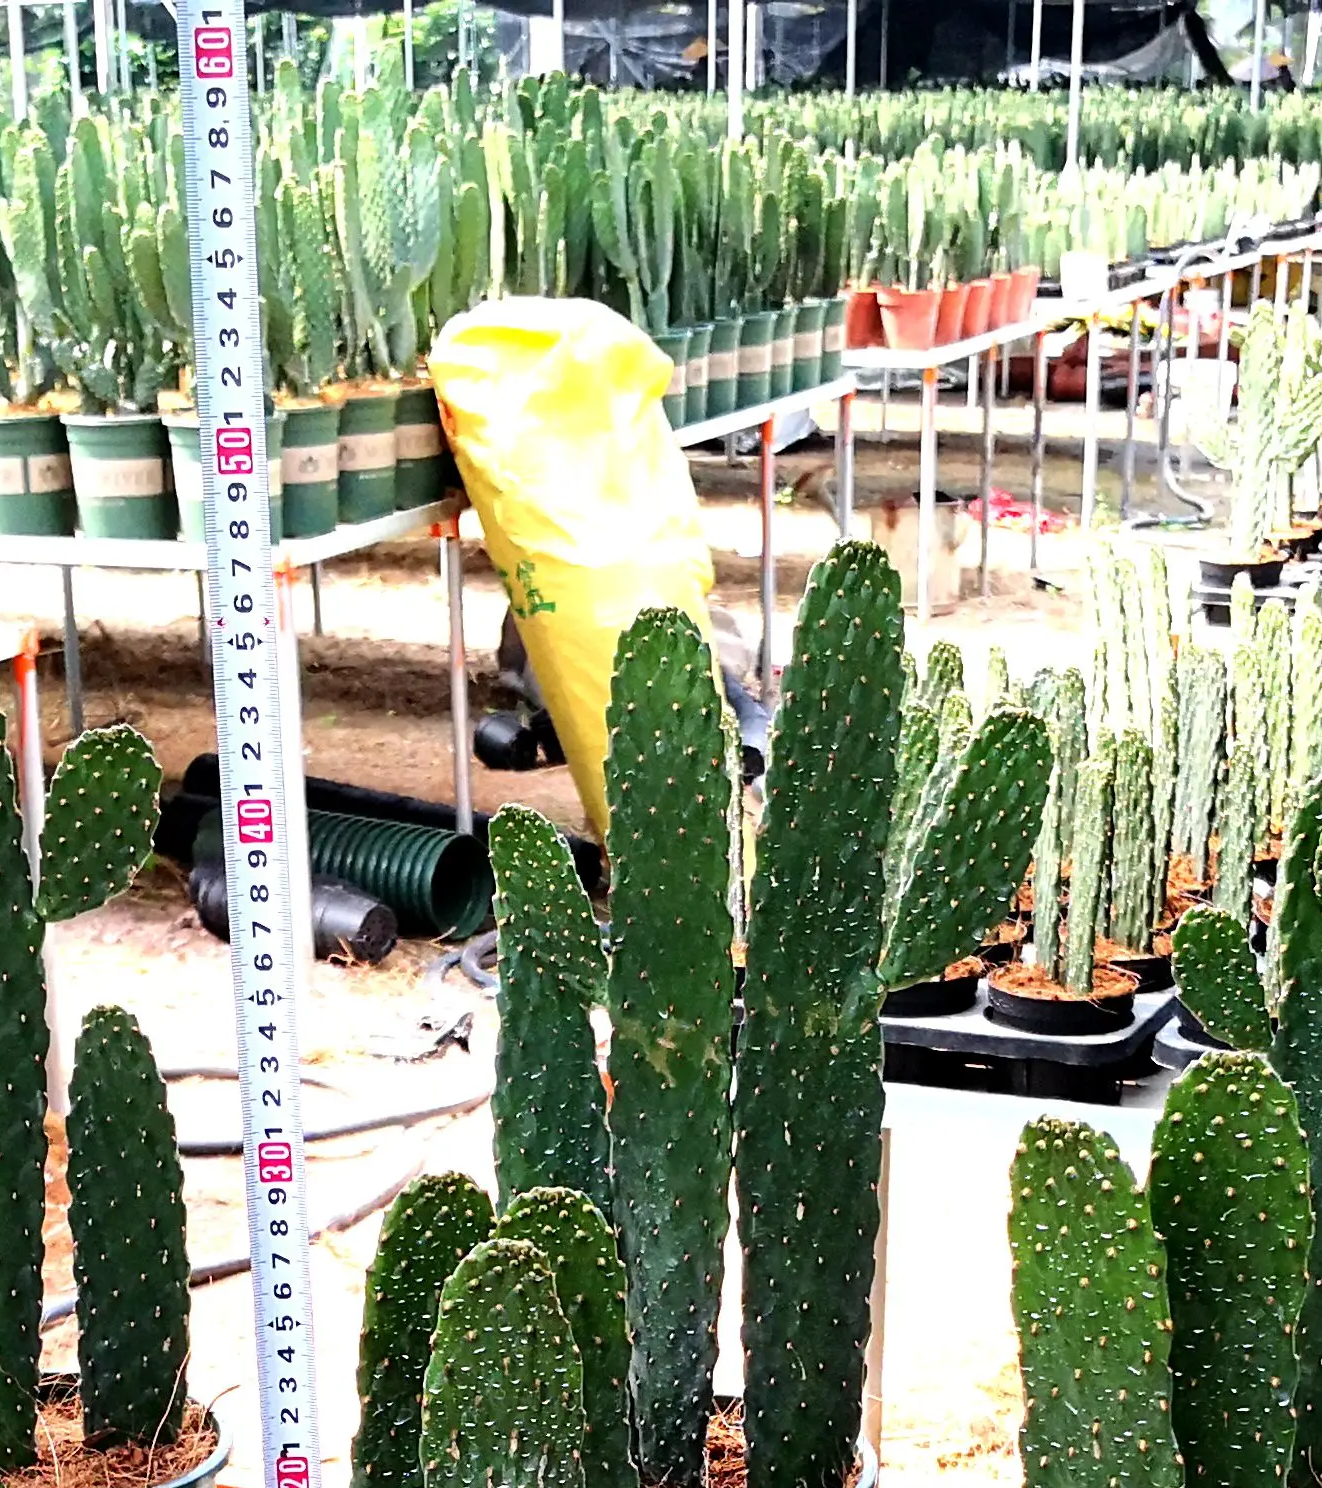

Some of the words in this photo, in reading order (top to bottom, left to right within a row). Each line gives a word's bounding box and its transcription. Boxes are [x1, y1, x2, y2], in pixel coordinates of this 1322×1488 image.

[201, 10, 222, 25] 1
[197, 31, 231, 74] 60
[206, 87, 227, 108] 9
[208, 127, 229, 148] 8
[210, 169, 231, 189] 7
[212, 207, 233, 228] 6
[214, 248, 235, 269] 5
[216, 288, 237, 310] 4
[219, 328, 240, 348] 3
[221, 366, 242, 387] 2
[223, 412, 243, 426] 1
[219, 432, 252, 471] 50
[227, 482, 248, 503] 9
[229, 520, 250, 539] 8
[231, 558, 251, 577] 7
[233, 594, 253, 613] 6
[235, 632, 255, 651] 5
[237, 668, 257, 689] 4
[239, 706, 259, 725] 3
[241, 742, 261, 761] 2
[243, 784, 263, 797] 1
[239, 803, 271, 840] 40
[247, 849, 267, 869] 9
[249, 884, 269, 903] 8
[251, 921, 271, 938] 7
[253, 953, 273, 971] 6
[255, 988, 275, 1006] 5
[258, 1022, 277, 1041] 4
[260, 1056, 279, 1073] 3
[262, 1089, 281, 1107] 2
[264, 1127, 283, 1140] 1
[260, 1146, 292, 1179] 30
[267, 1187, 287, 1205] 9
[269, 1219, 289, 1236] 8
[271, 1253, 291, 1269] 7
[273, 1282, 292, 1300] 6
[275, 1315, 294, 1332] 5
[276, 1345, 295, 1364] 4
[278, 1377, 297, 1393] 3
[280, 1407, 299, 1424] 2
[280, 1442, 300, 1457] 1
